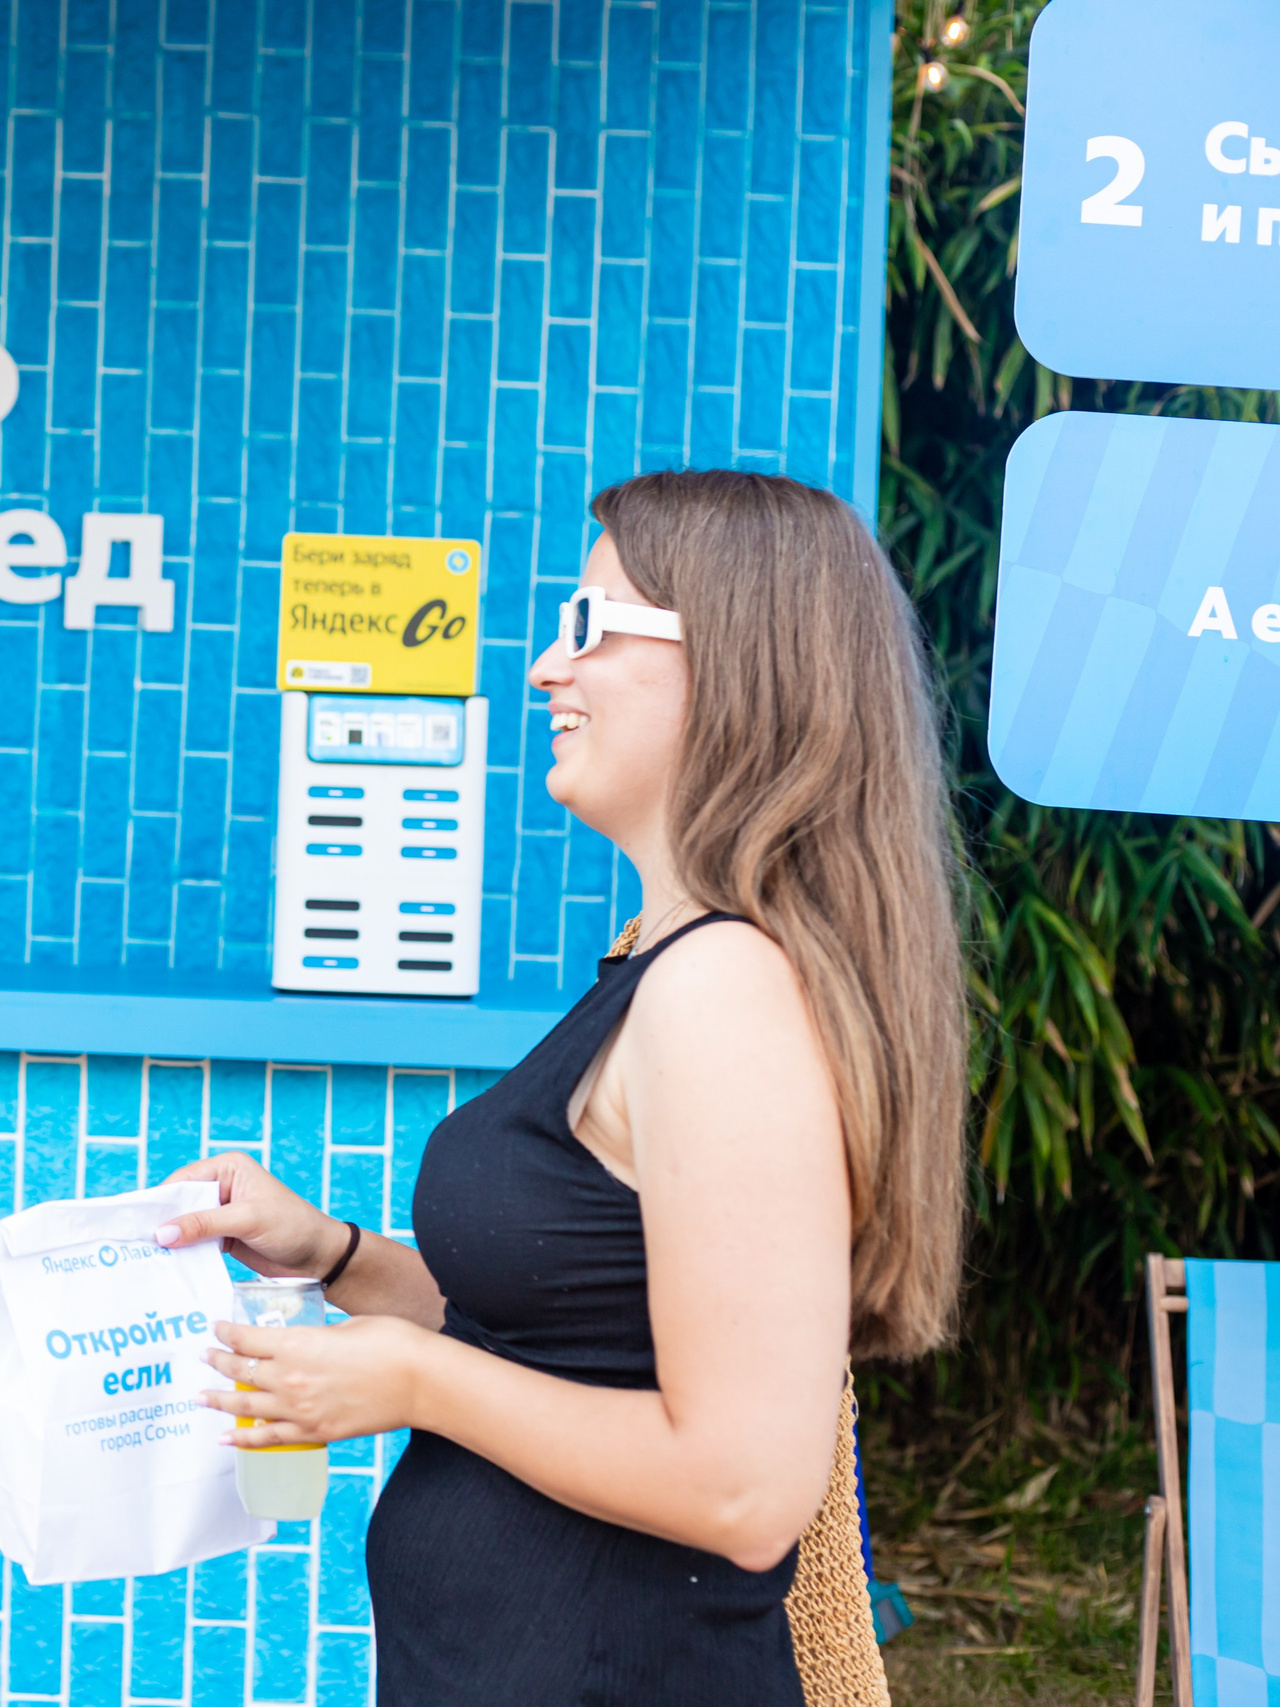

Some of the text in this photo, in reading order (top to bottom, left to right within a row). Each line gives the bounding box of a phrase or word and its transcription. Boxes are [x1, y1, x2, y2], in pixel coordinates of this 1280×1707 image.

[1081, 135, 1145, 227] 2
[1201, 203, 1242, 244] и
[293, 544, 411, 569] Бери заряд
[293, 579, 381, 597] теперь в
[291, 598, 466, 648] Яндекс Go
[1187, 586, 1238, 640] А
[42, 1256, 96, 1274] Яндекс
[46, 1311, 208, 1360] Откройте
[103, 1361, 173, 1396] если
[65, 1399, 200, 1436] готовы расцелов
[100, 1423, 191, 1452] город Сочи
